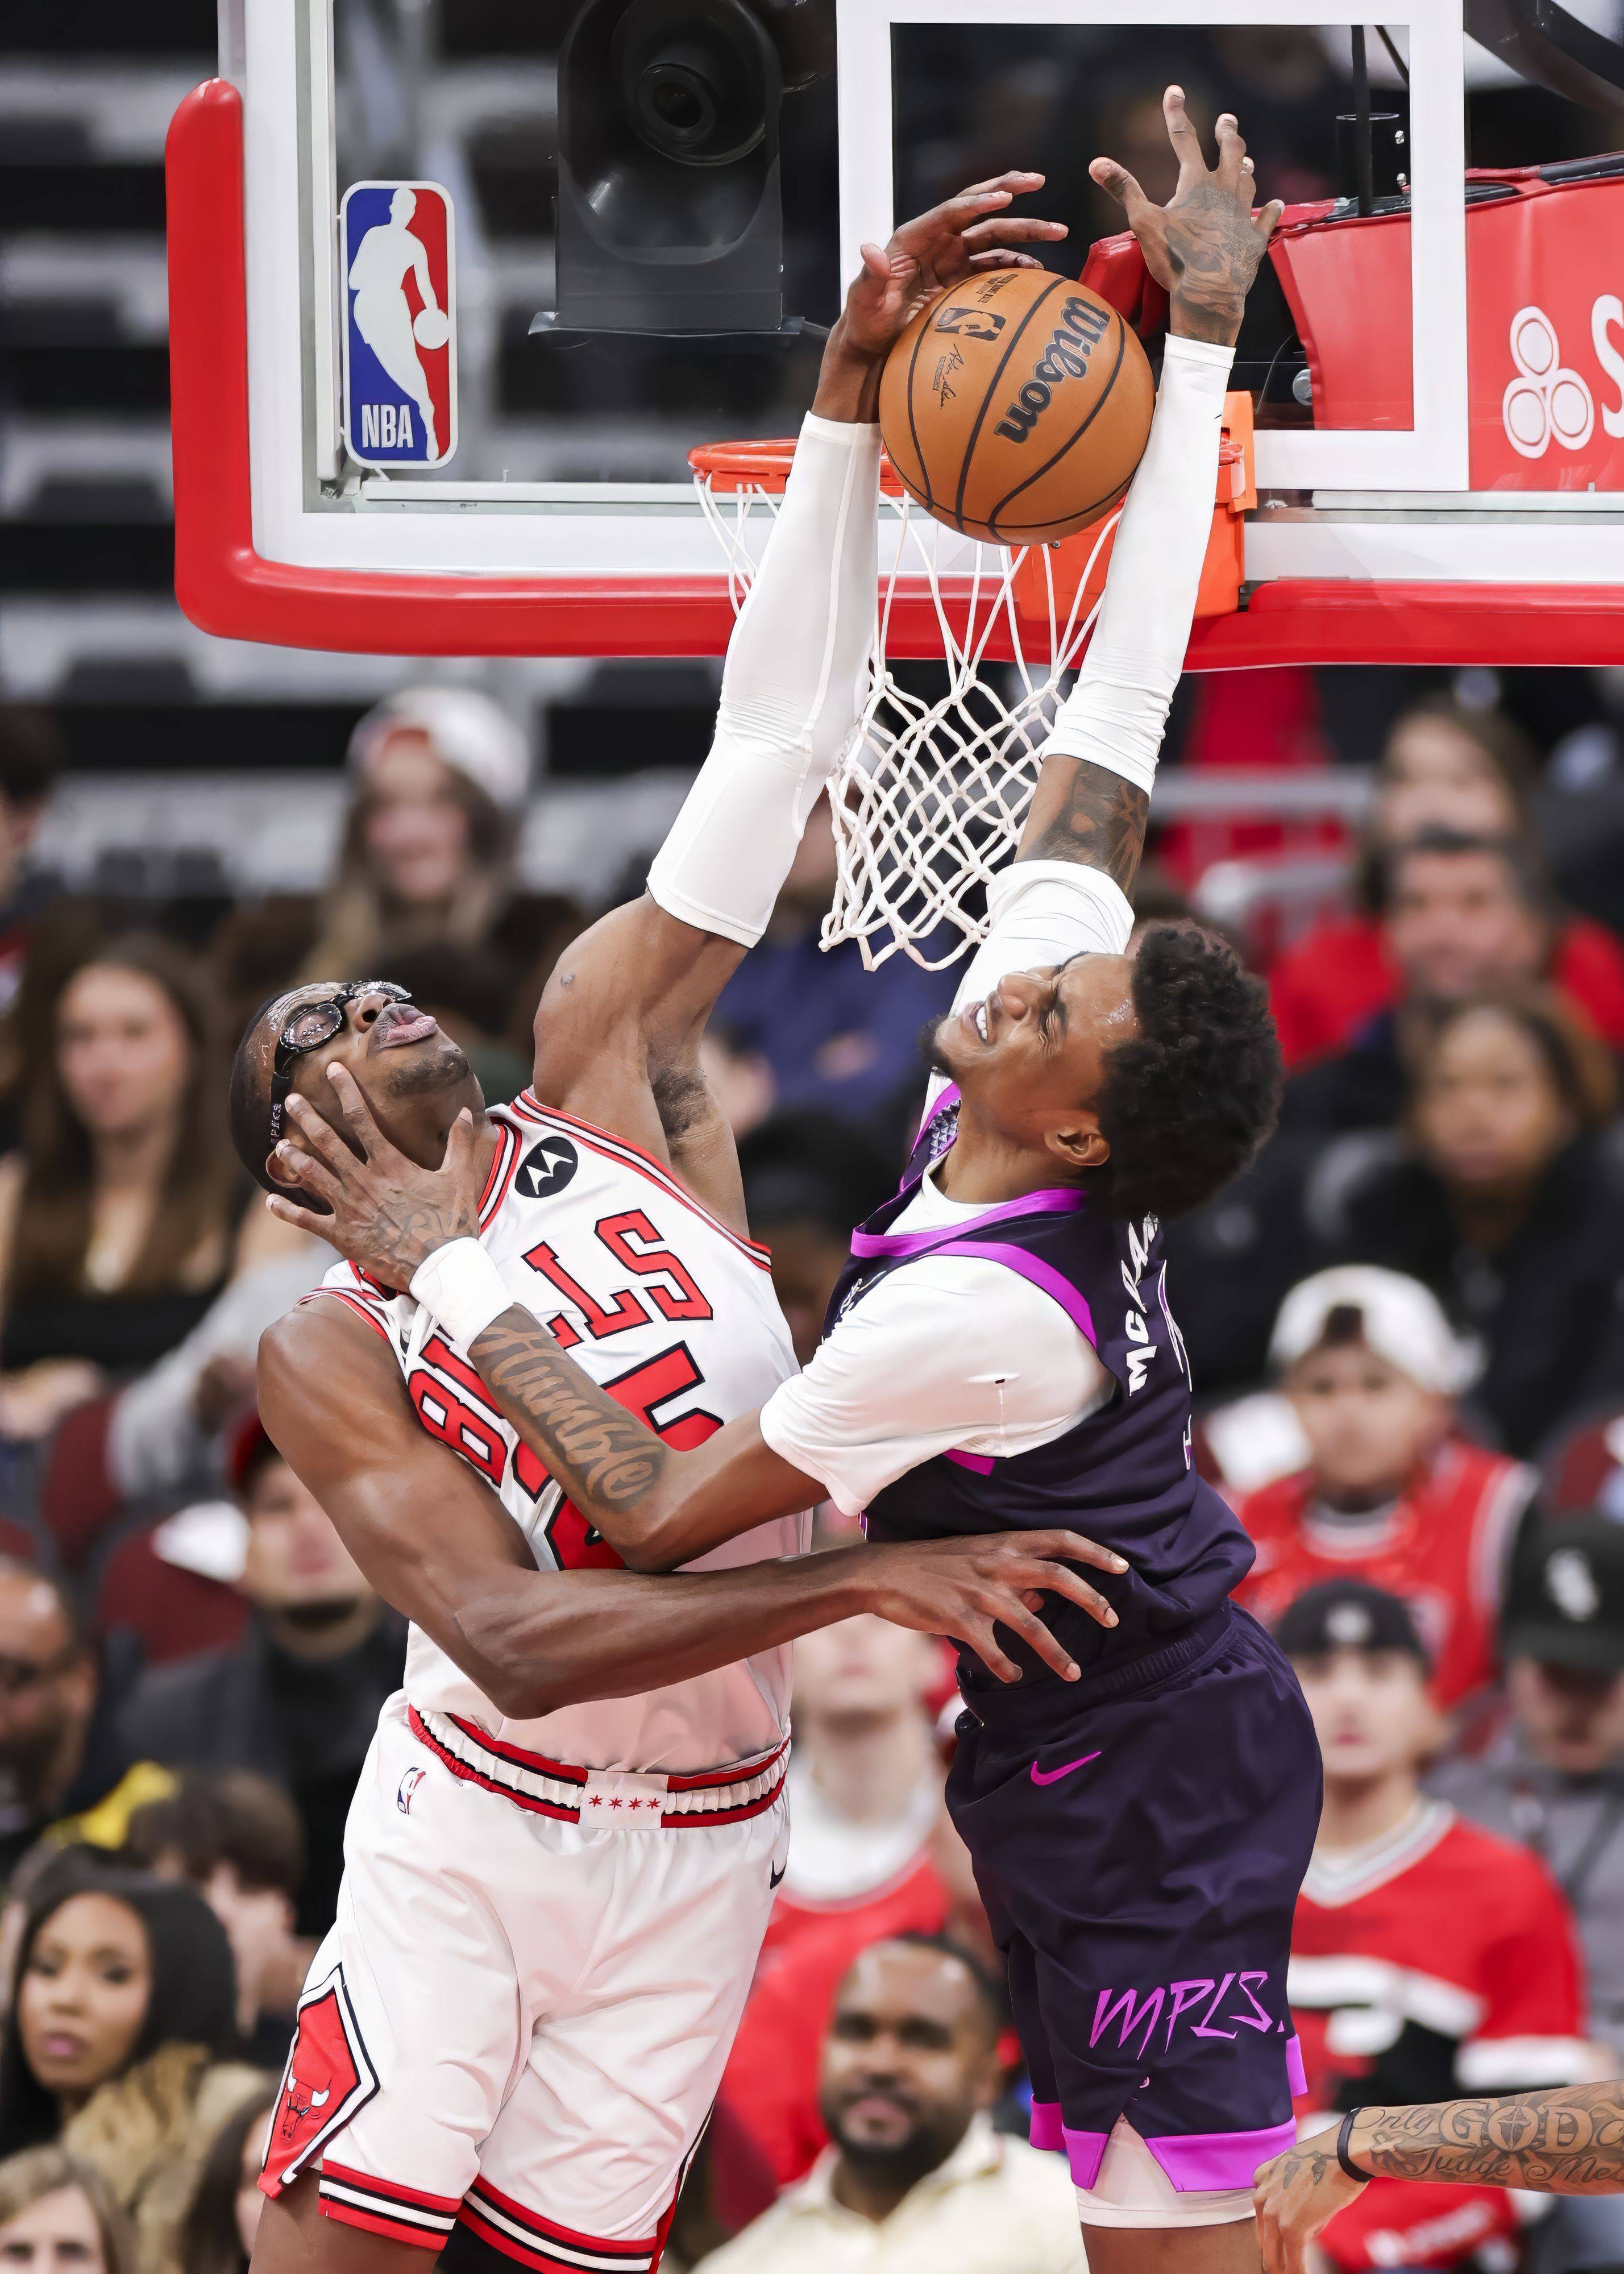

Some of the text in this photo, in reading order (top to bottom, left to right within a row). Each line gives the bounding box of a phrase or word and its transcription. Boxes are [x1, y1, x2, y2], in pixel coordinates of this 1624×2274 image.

[994, 296, 1111, 445] Wilson
[362, 404, 414, 448] NBA
[1440, 2100, 1592, 2155] GOD
